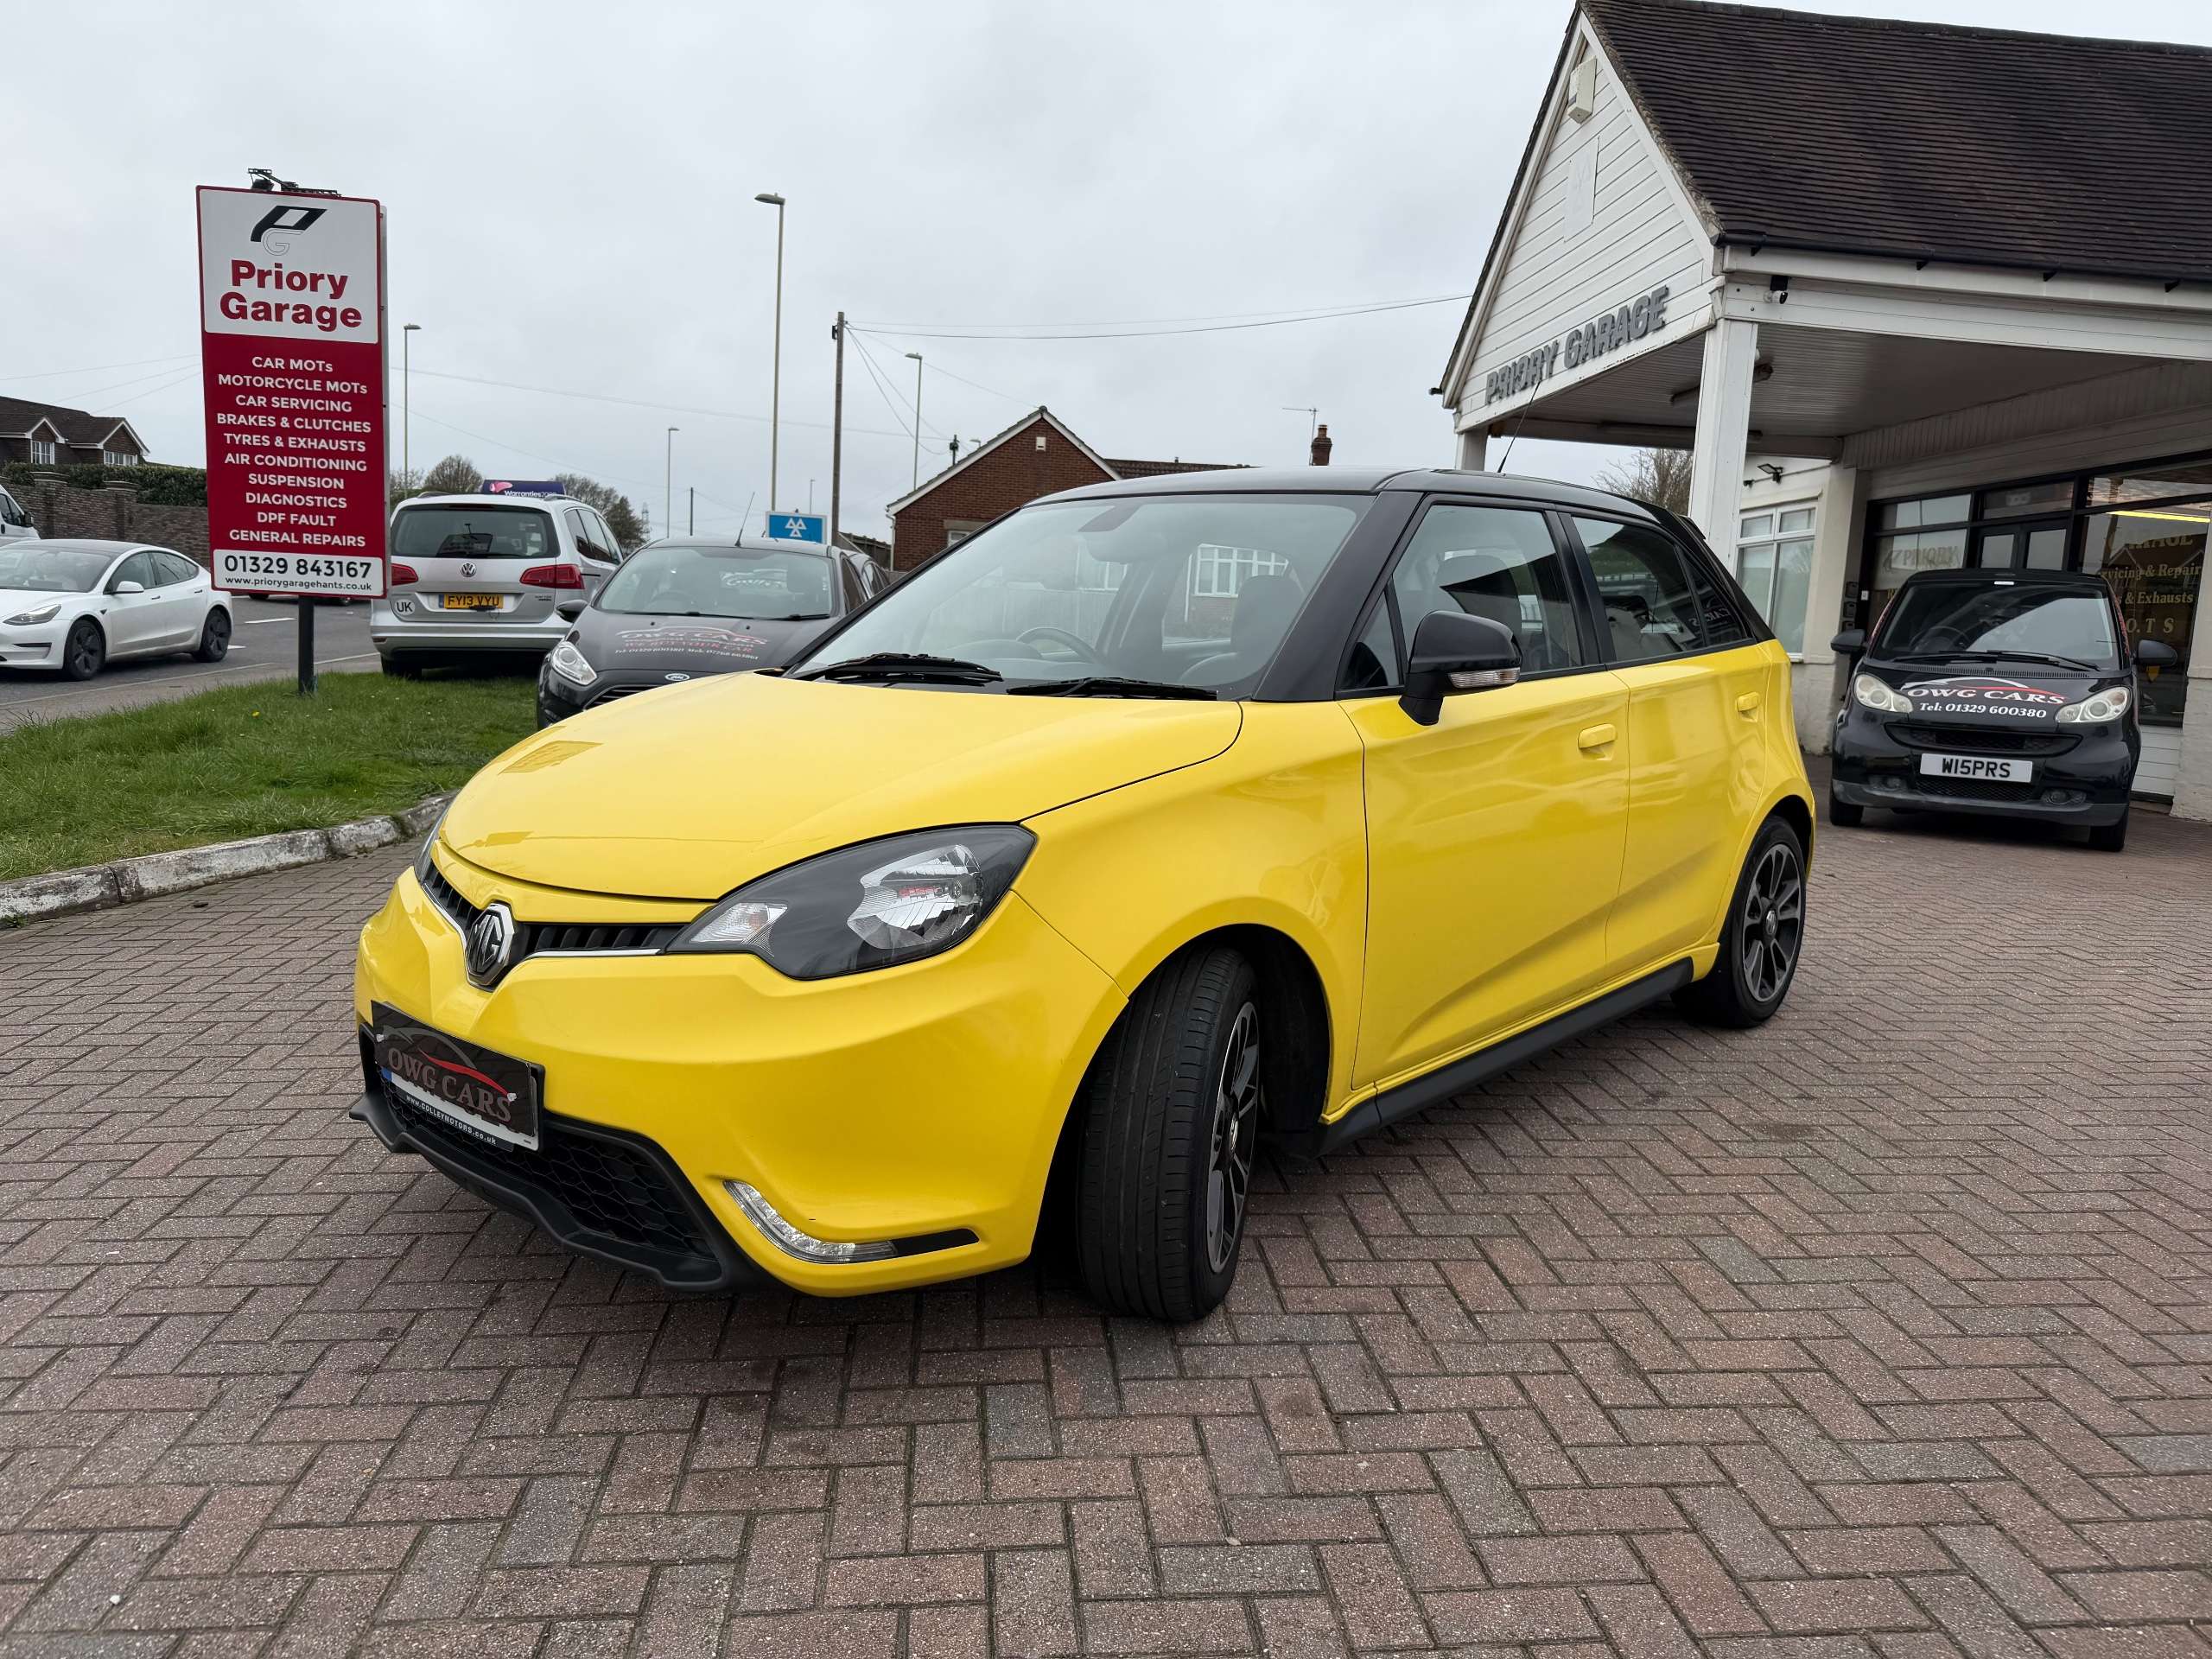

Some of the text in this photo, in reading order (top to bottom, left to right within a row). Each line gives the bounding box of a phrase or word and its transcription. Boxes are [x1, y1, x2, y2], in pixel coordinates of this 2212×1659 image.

[231, 259, 348, 300] Priory
[219, 291, 363, 333] Garage
[1484, 284, 1669, 406] PRIORY GARAGE
[251, 356, 334, 372] CAR MOTs
[218, 373, 368, 394] MOTORCYCLE MOTs
[235, 394, 353, 413] CAR SERVICING
[216, 413, 372, 433] BRAKES & CLUTCHES
[224, 433, 366, 453] TYRES & EXHAUSTS
[224, 453, 367, 472] AIR CONDITIONING
[248, 474, 345, 490] SUSPENSION
[245, 492, 347, 509] DIAGNOSTICS
[257, 512, 336, 527] DPF FAULT
[229, 529, 366, 547] GENERAL REPAIRS
[224, 555, 372, 579] 01329 843167
[2145, 564, 2157, 577] &
[225, 575, 372, 591] www.priorygaragehants.co.uk
[447, 594, 500, 607] FY13 VYU
[2124, 591, 2134, 605] &
[2136, 590, 2195, 605] Exhausts
[396, 601, 414, 614] UK
[1907, 689, 2066, 705] OWG CARS
[1919, 702, 2047, 719] Tel: 01329 600380
[389, 1047, 512, 1123] OWG CARS
